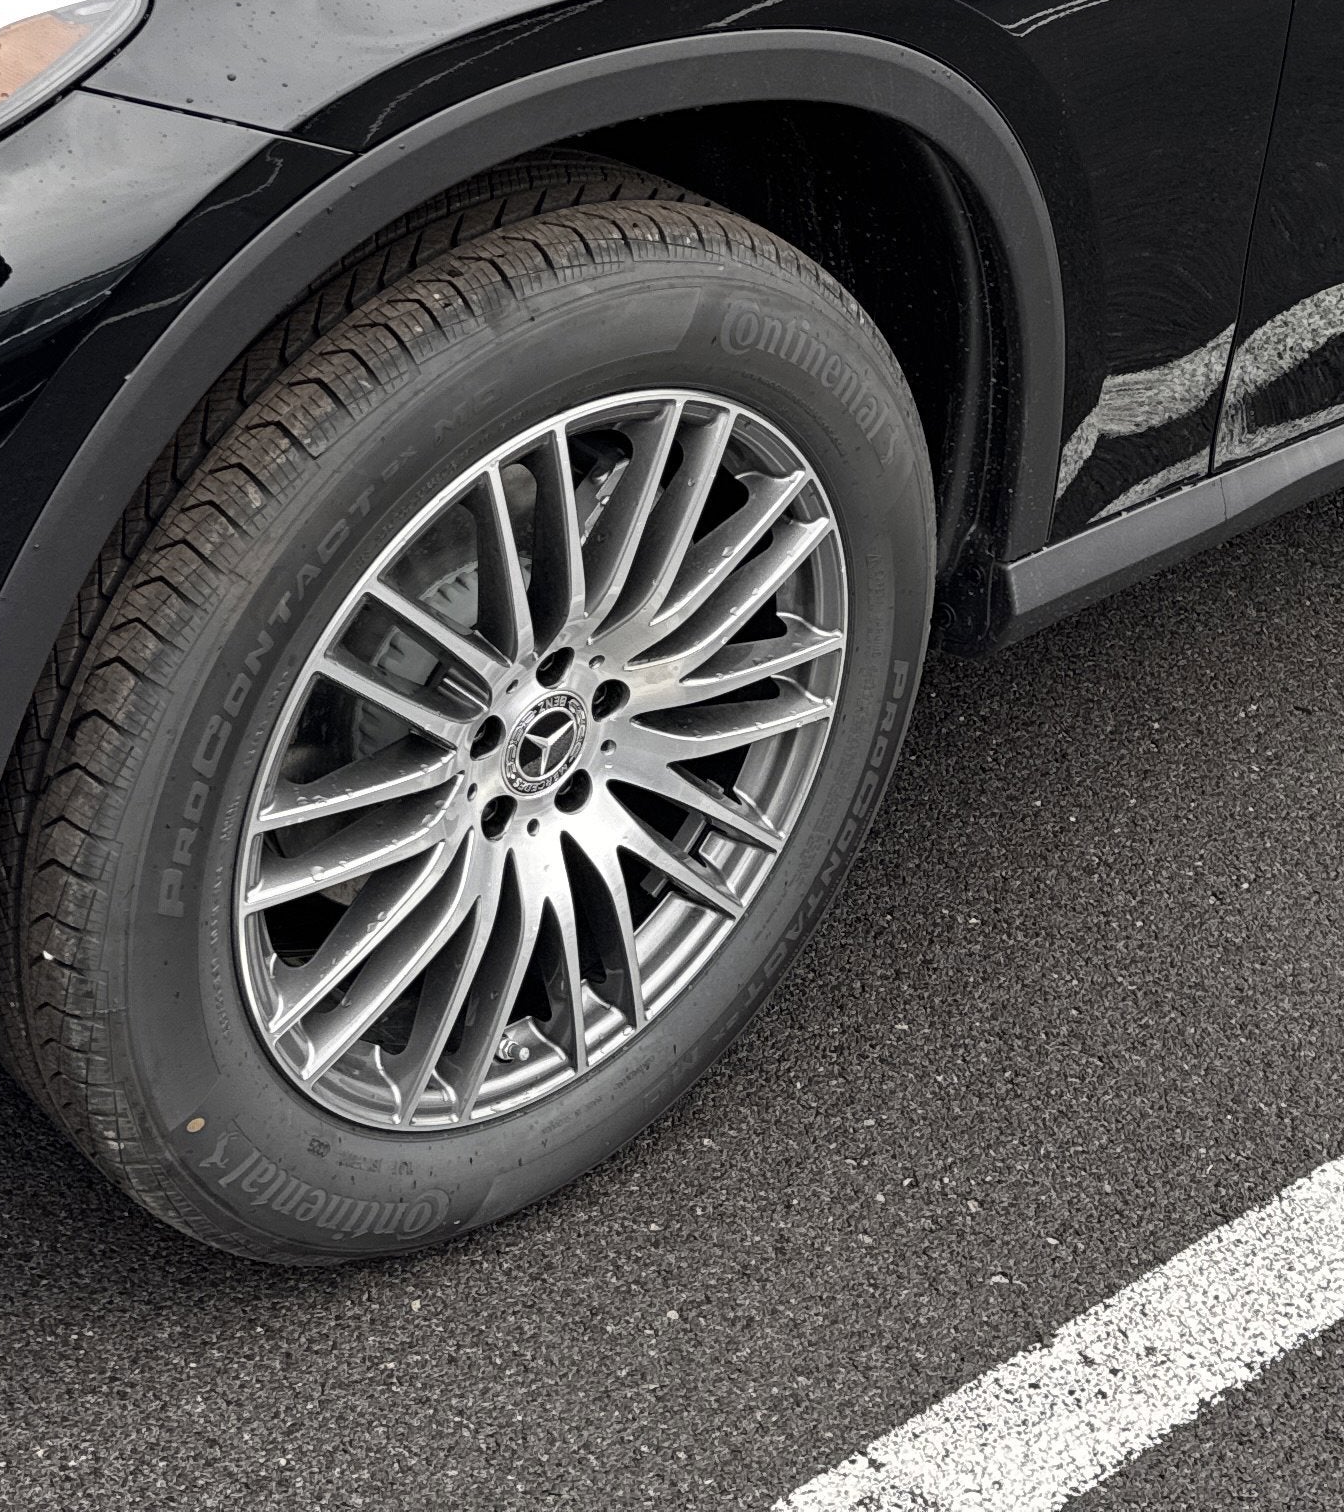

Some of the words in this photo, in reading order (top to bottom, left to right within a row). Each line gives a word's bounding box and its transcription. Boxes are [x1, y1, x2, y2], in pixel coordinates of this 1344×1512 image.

[720, 299, 890, 441] Continental
[537, 695, 568, 715] BENZ
[512, 763, 569, 793] MERCEDES
[218, 1146, 452, 1240] Continental
